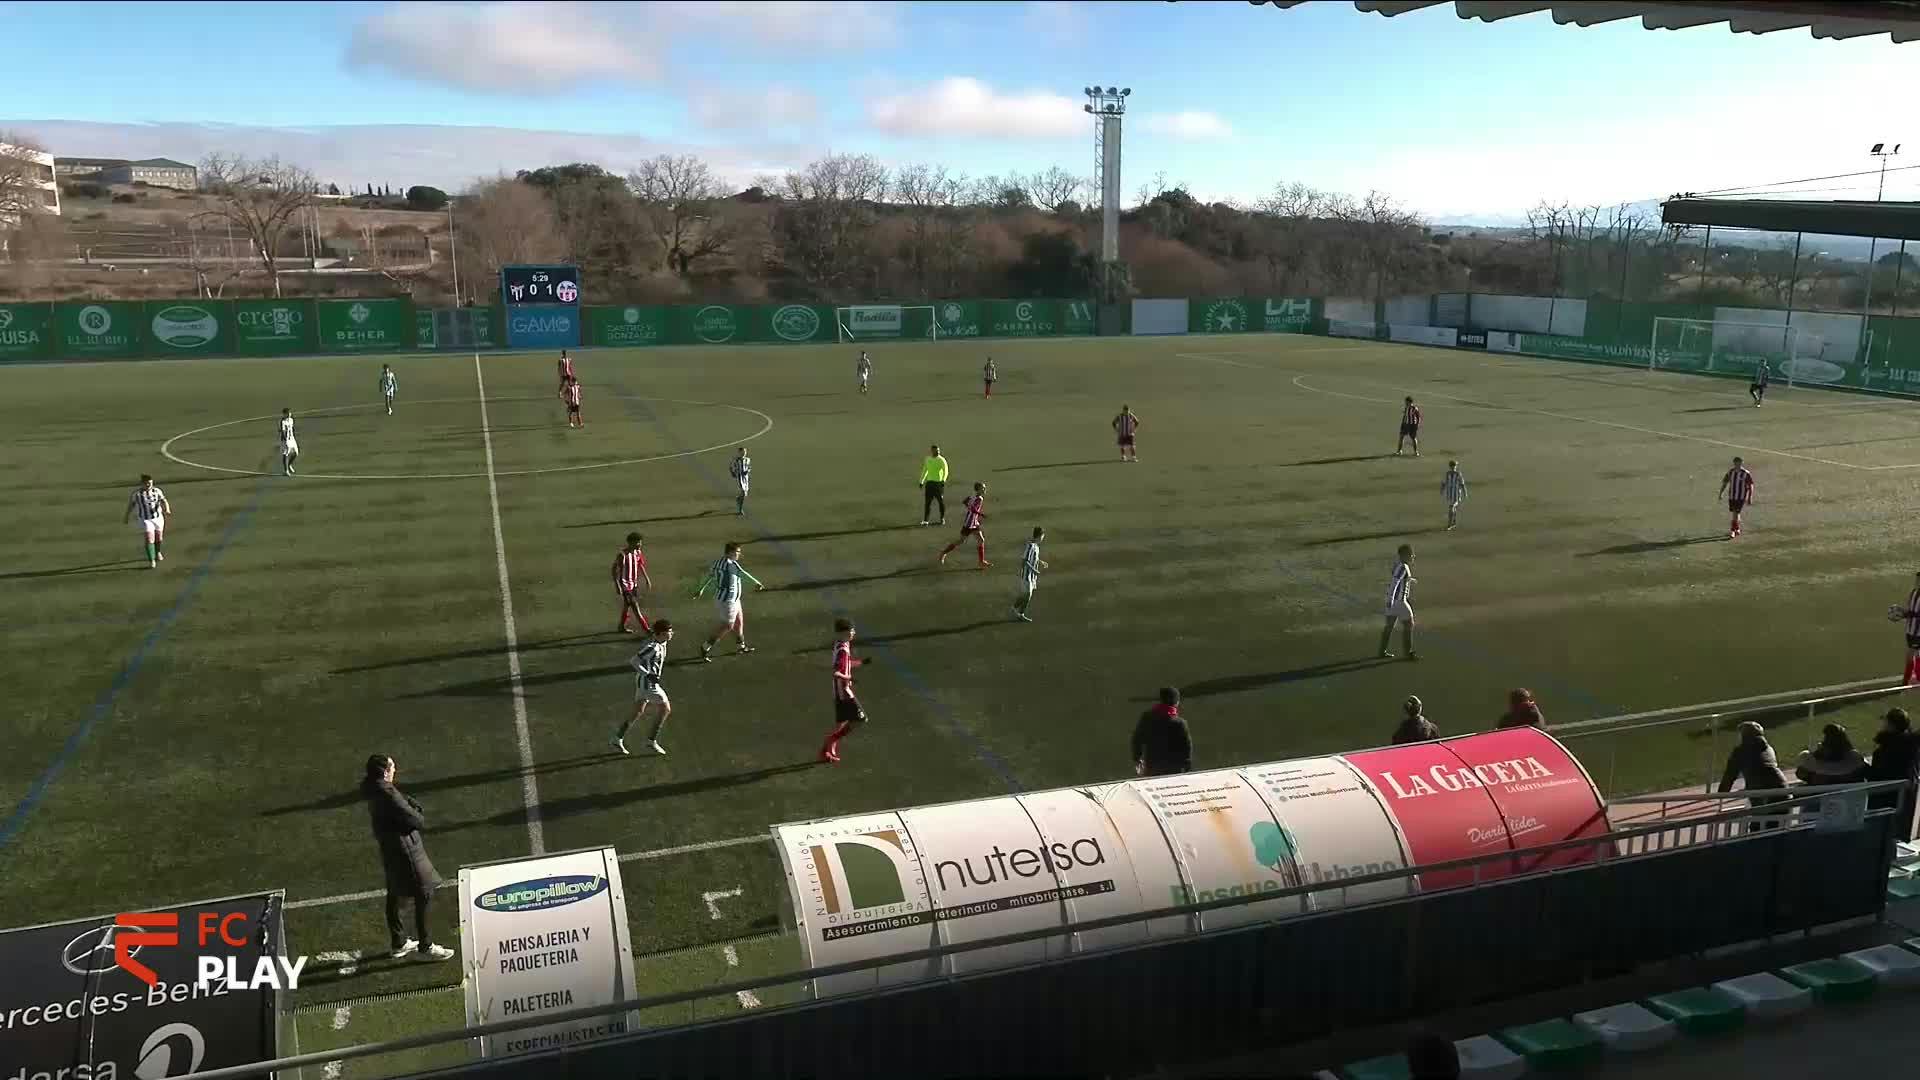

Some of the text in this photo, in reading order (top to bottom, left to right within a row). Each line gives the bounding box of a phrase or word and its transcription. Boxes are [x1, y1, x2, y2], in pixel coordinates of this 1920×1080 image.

[529, 284, 553, 296] 0 1
[238, 308, 302, 335] crego
[0, 331, 40, 345] UISA
[336, 330, 385, 341] BEHER
[1379, 756, 1554, 799] LA GACETA
[934, 837, 1105, 891] nutersa
[481, 874, 600, 907] Europillow
[499, 926, 591, 955] MENSAJERIA Y
[826, 915, 921, 939] Asesoramiento
[500, 948, 580, 974] PAQUETERIA
[0, 976, 229, 1029] rcedes-Benz
[503, 989, 573, 1016] PALETERIA
